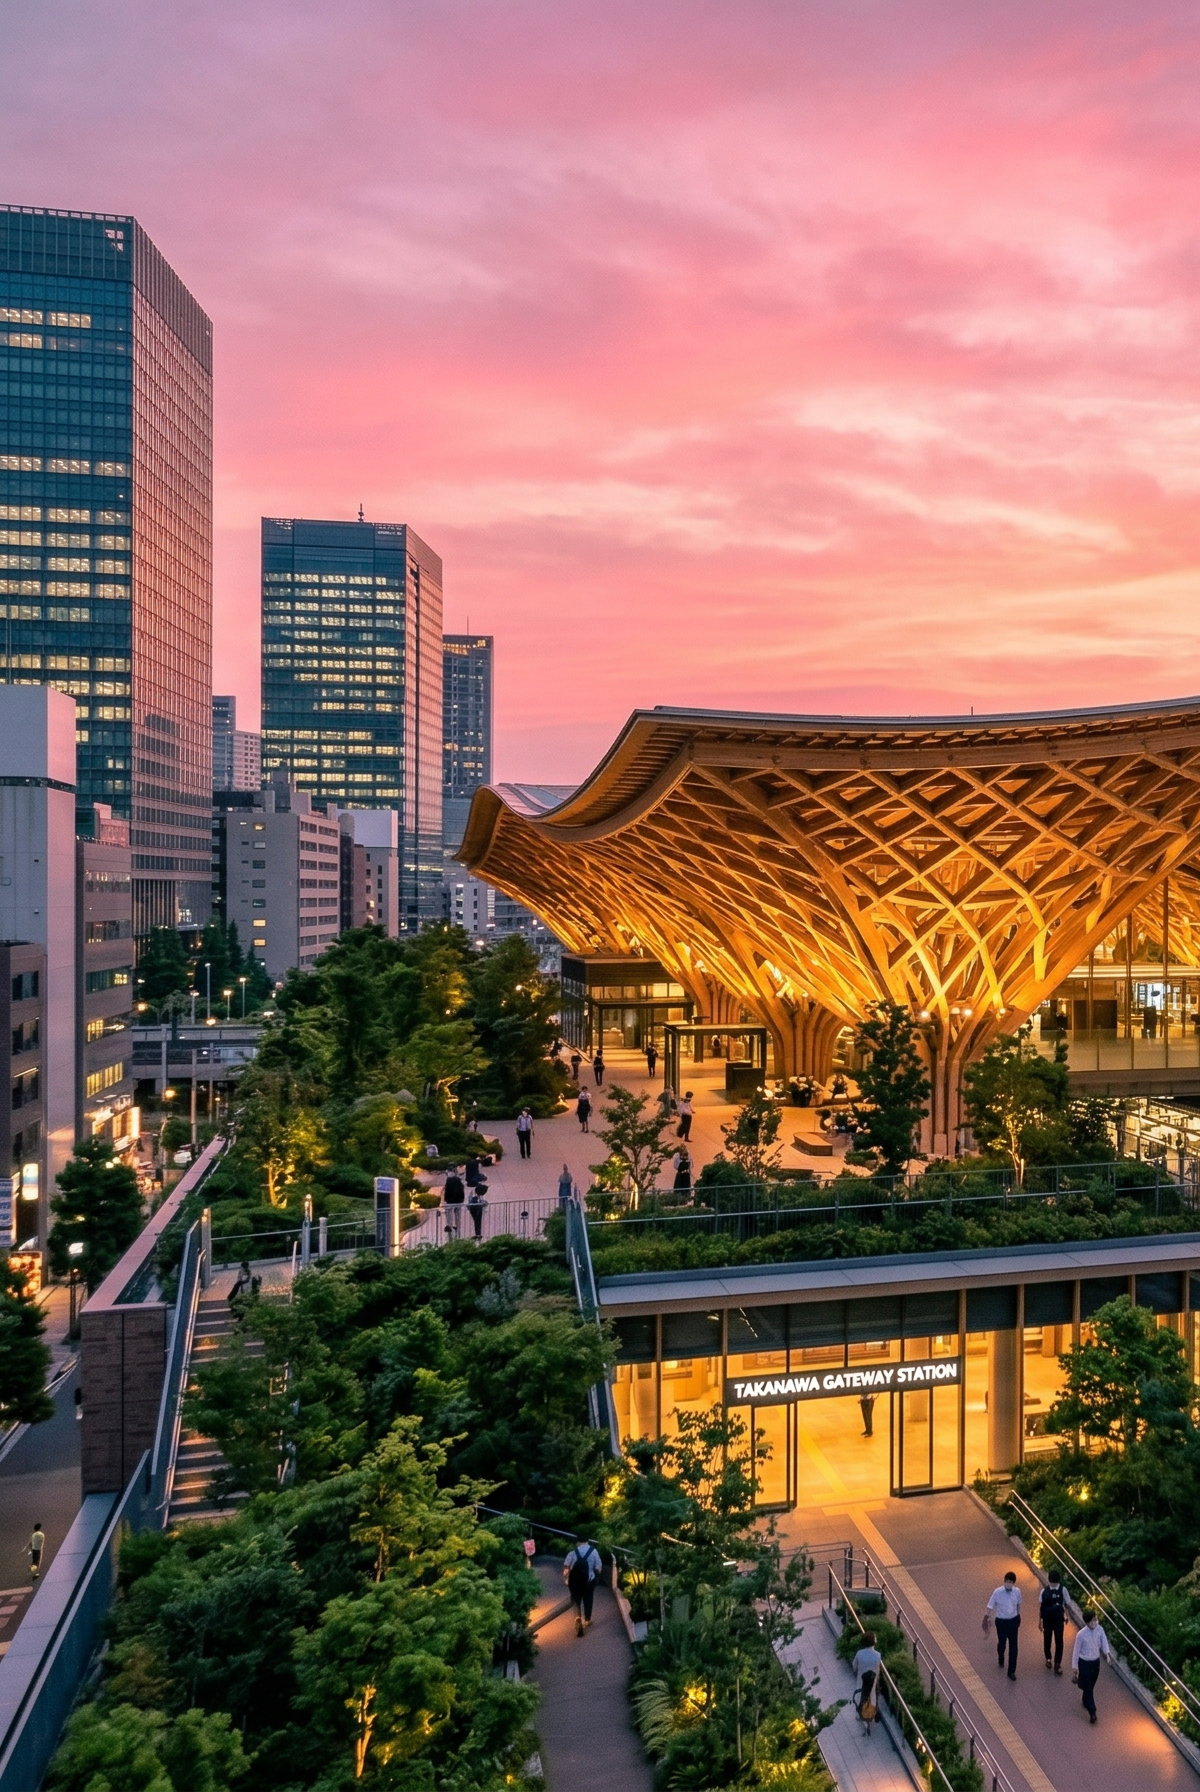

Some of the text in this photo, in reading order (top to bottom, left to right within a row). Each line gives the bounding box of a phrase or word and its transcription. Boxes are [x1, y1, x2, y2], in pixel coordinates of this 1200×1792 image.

[734, 1364, 957, 1398] TAKANAWA GATEWAY STATION
